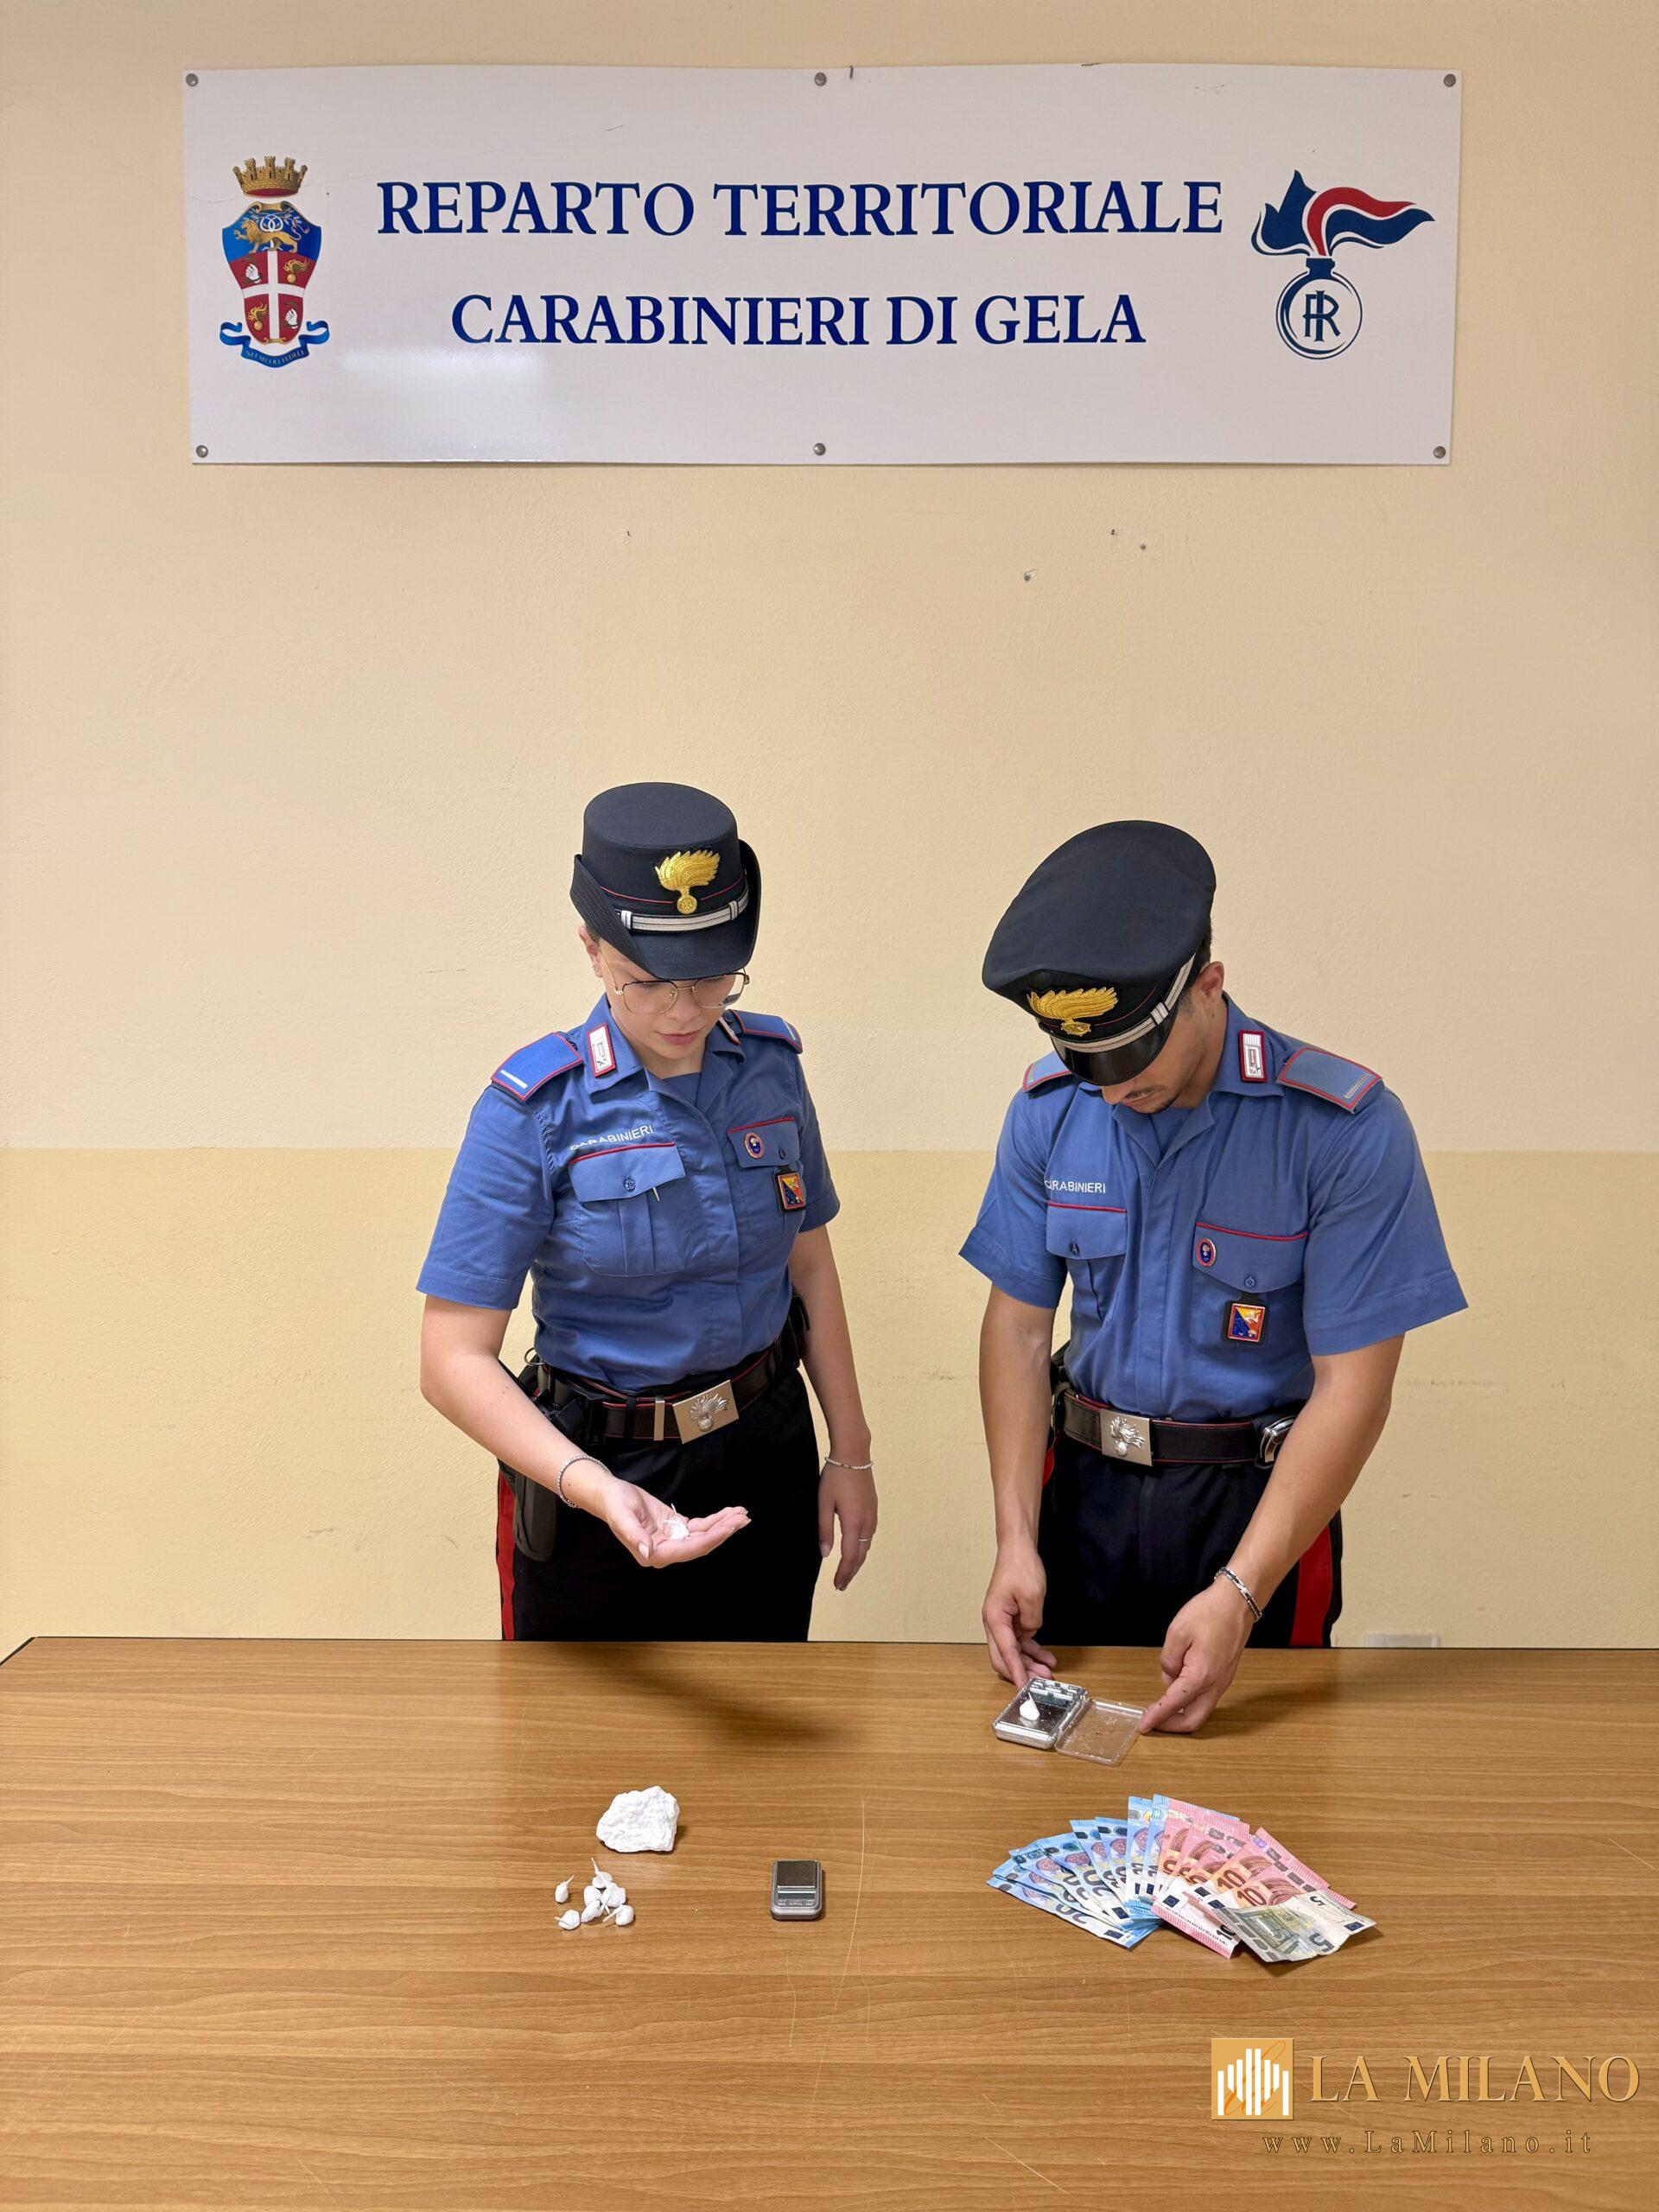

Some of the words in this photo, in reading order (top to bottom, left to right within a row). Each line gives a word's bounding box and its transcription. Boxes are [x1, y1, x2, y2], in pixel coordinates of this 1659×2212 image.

[377, 181, 695, 237] REPARTO
[713, 181, 1223, 237] TERRITORIALE
[451, 294, 870, 346] CARABINIERI
[886, 296, 958, 345] DI
[975, 294, 1147, 345] GELA
[1217, 1870, 1246, 1890] 10
[1236, 1888, 1268, 1907] 10
